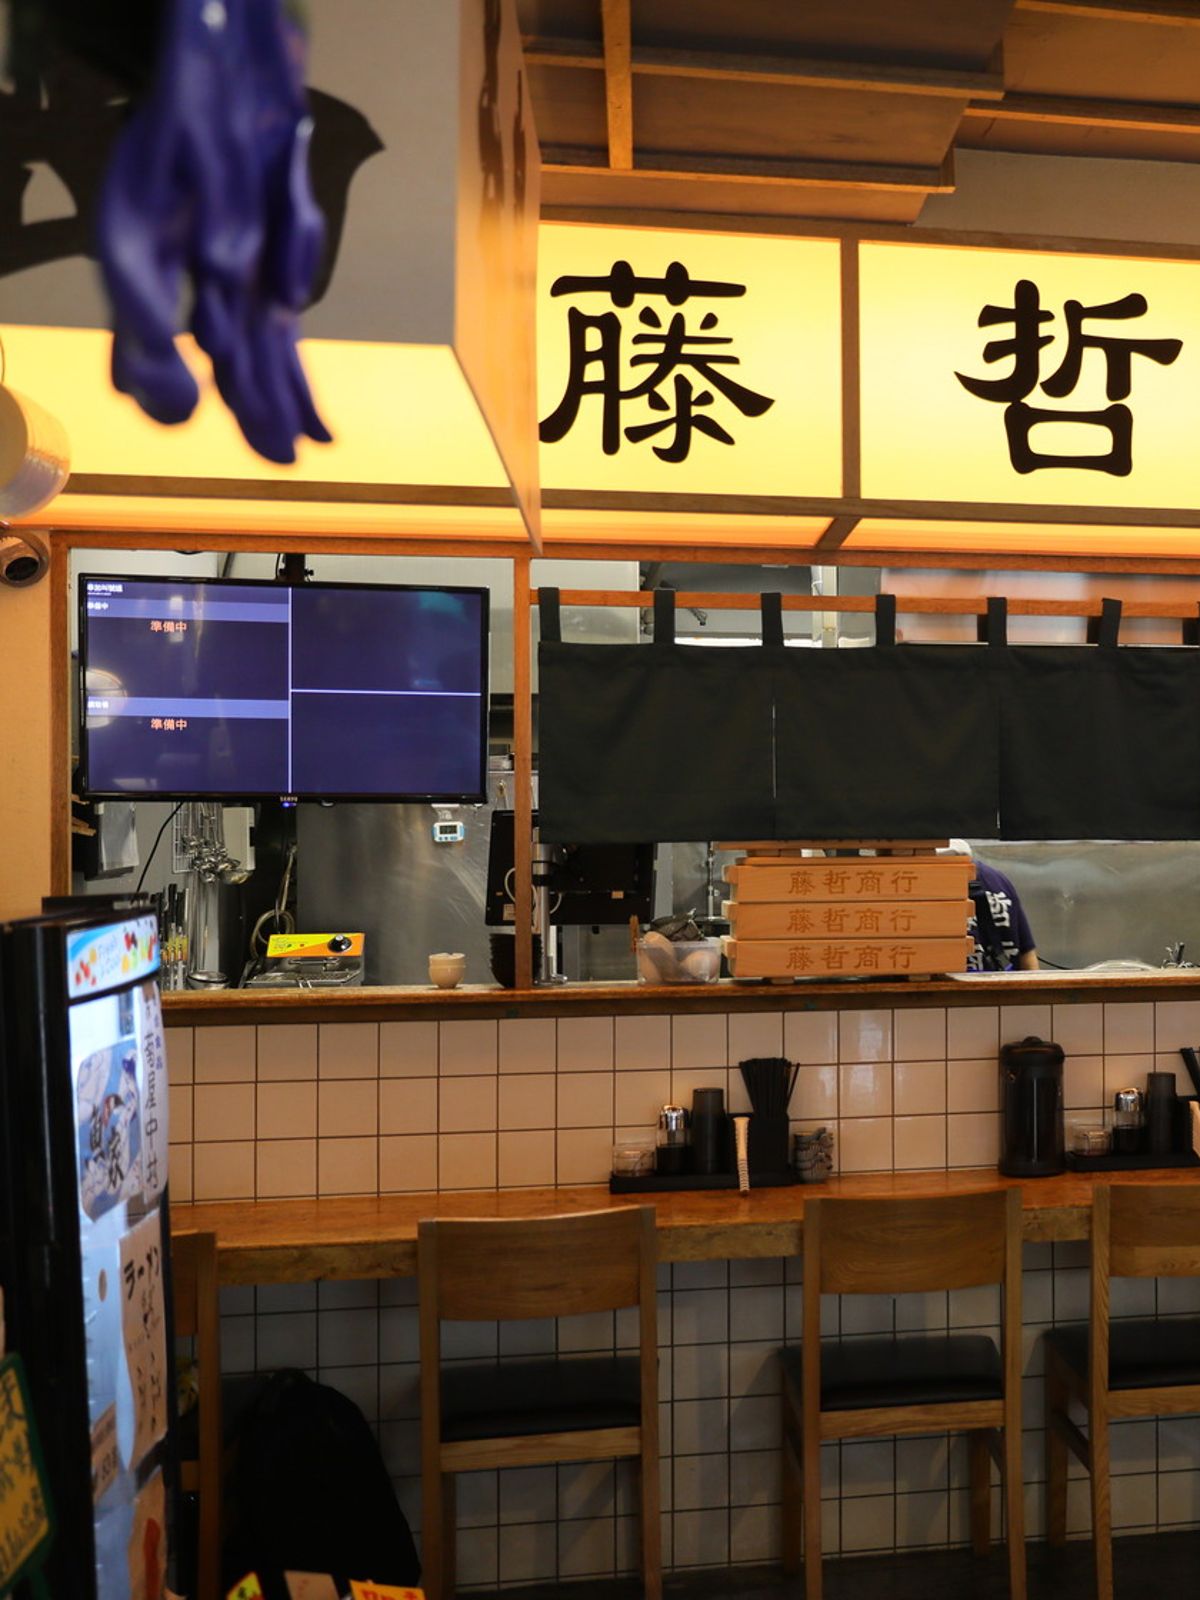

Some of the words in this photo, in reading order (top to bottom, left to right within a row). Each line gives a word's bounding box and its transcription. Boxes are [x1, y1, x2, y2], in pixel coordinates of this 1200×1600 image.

[150, 620, 187, 632] 準備中
[150, 718, 187, 731] 準備中
[788, 869, 919, 895] 藤哲商行
[786, 908, 917, 933] 藤哲商行
[785, 945, 918, 971] 藤哲商行
